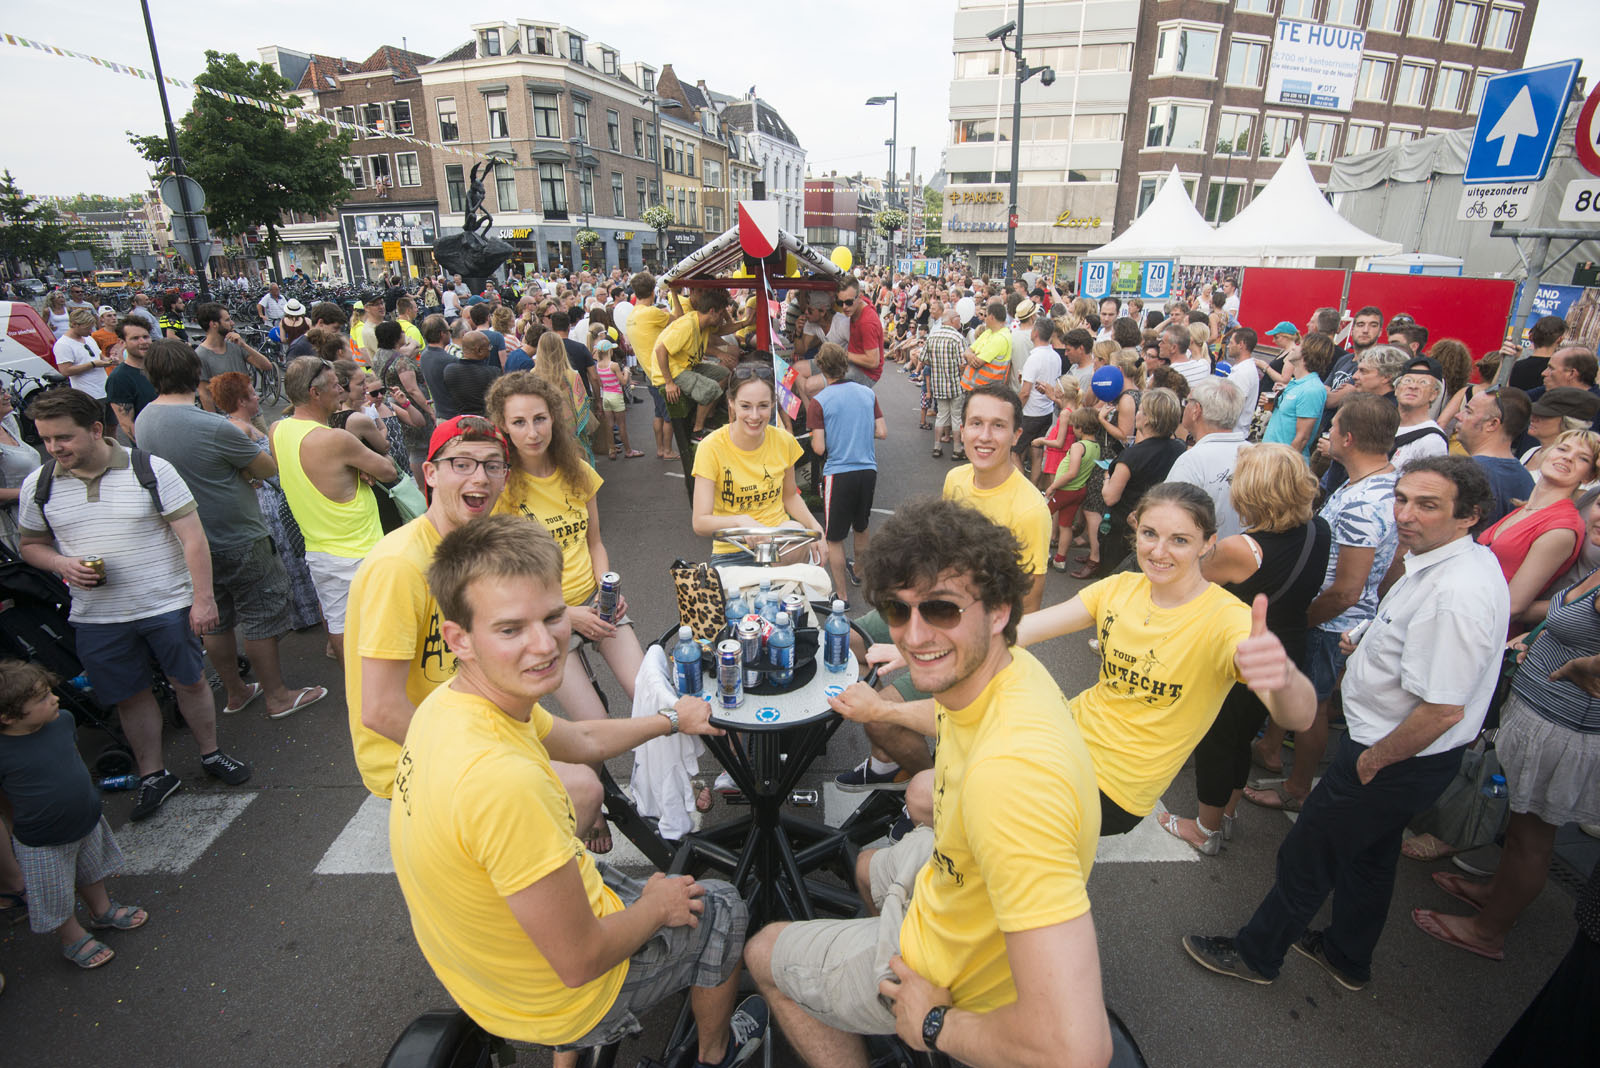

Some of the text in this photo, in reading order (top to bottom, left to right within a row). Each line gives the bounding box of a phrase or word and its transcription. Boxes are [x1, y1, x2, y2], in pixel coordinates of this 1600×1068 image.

[1279, 21, 1363, 51] TE HUUR
[963, 191, 1004, 203] PARKER
[1467, 185, 1529, 198] uitgezonderd
[948, 212, 1008, 233] WATERMA
[499, 228, 532, 240] SUBWAY
[615, 231, 636, 241] SUBWAY
[1090, 265, 1105, 280] ZO
[1150, 265, 1166, 280] ZO
[1521, 297, 1561, 310] PART
[736, 486, 782, 503] UTRECH
[740, 484, 758, 493] TOUR
[545, 514, 564, 525] TOUR
[550, 518, 589, 539] TREC
[1113, 648, 1137, 664] TOUR
